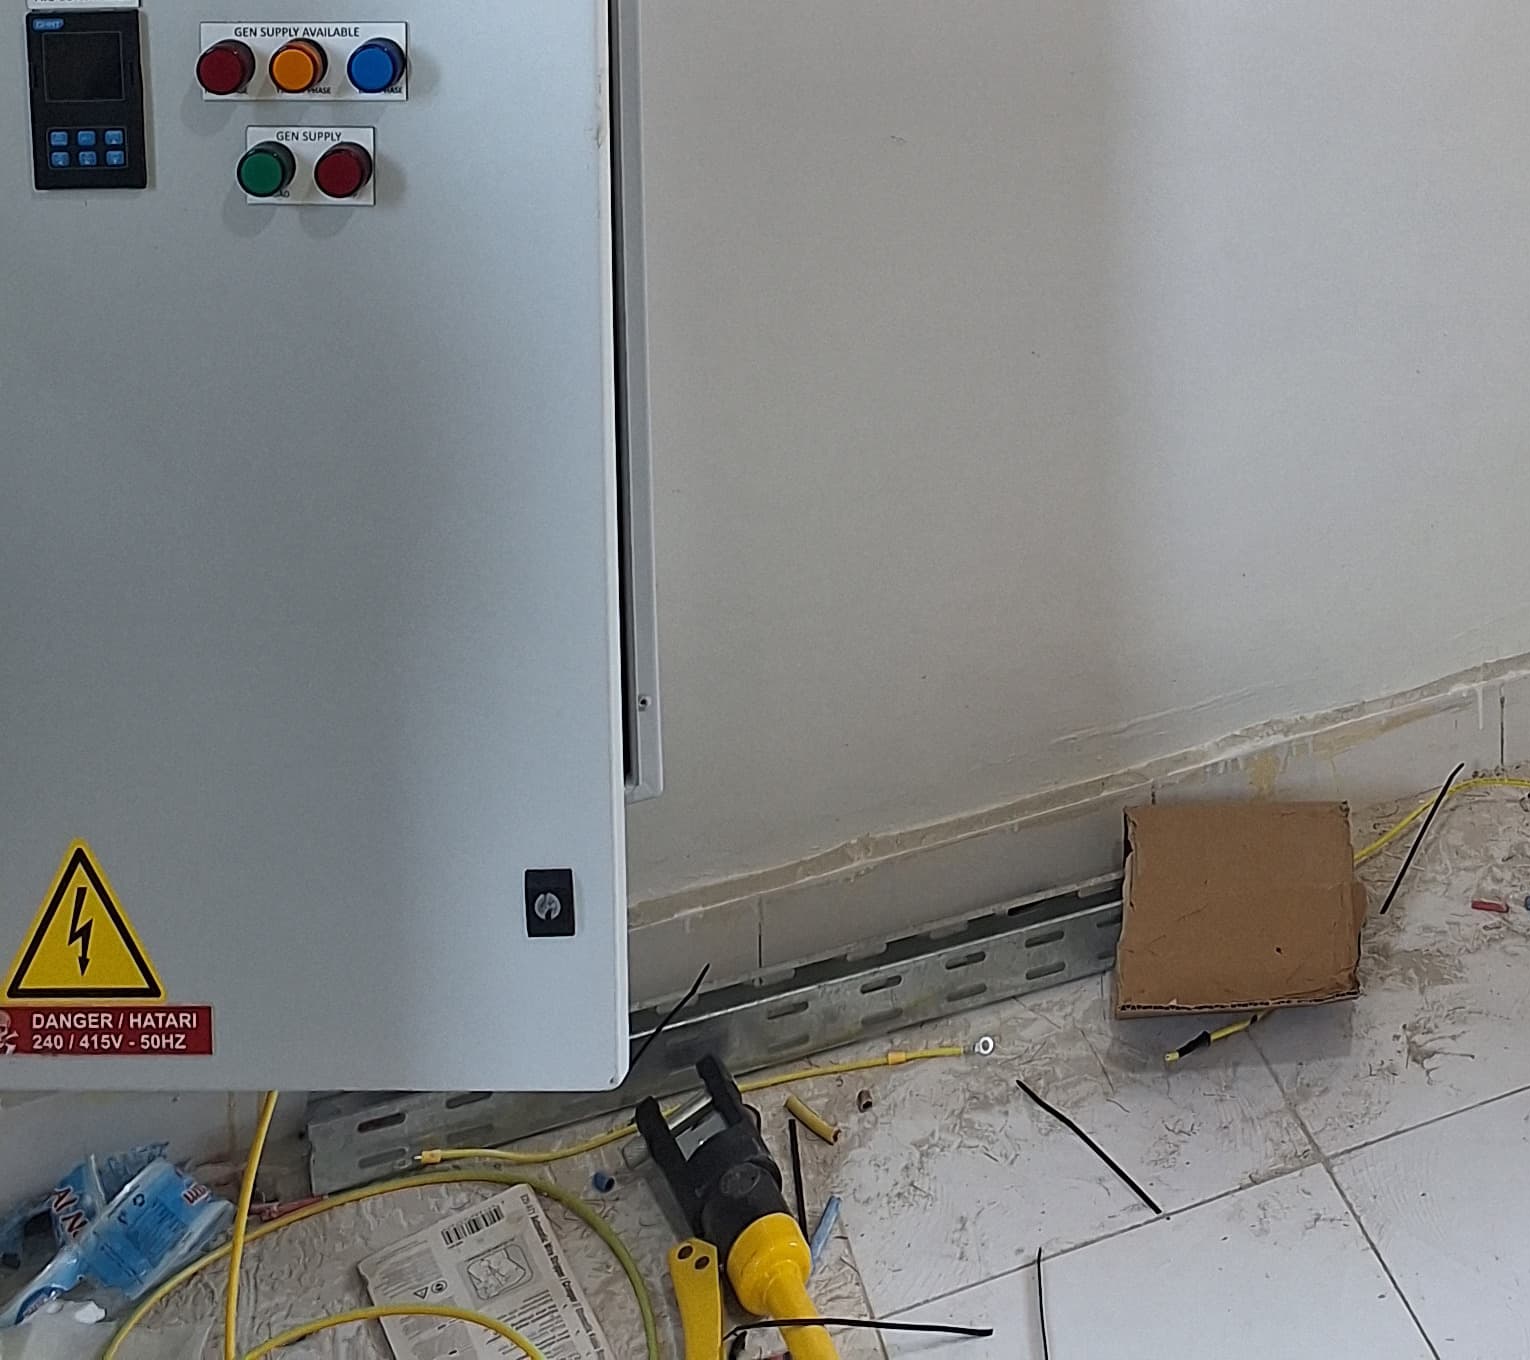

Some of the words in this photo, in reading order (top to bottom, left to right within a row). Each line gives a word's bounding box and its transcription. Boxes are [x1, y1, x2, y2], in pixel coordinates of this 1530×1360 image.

[234, 27, 257, 38] GEN
[260, 27, 299, 38] SUPPLY
[302, 27, 360, 38] AVAILABLE
[276, 131, 299, 141] GEN
[302, 131, 342, 141] SUPPLY
[32, 1013, 113, 1028] DANGER
[118, 1013, 124, 1028] /
[129, 1013, 197, 1028] HATARI
[32, 1034, 64, 1049] 240
[68, 1034, 74, 1049] /
[79, 1034, 123, 1049] 415V
[141, 1034, 187, 1049] 50HZ
